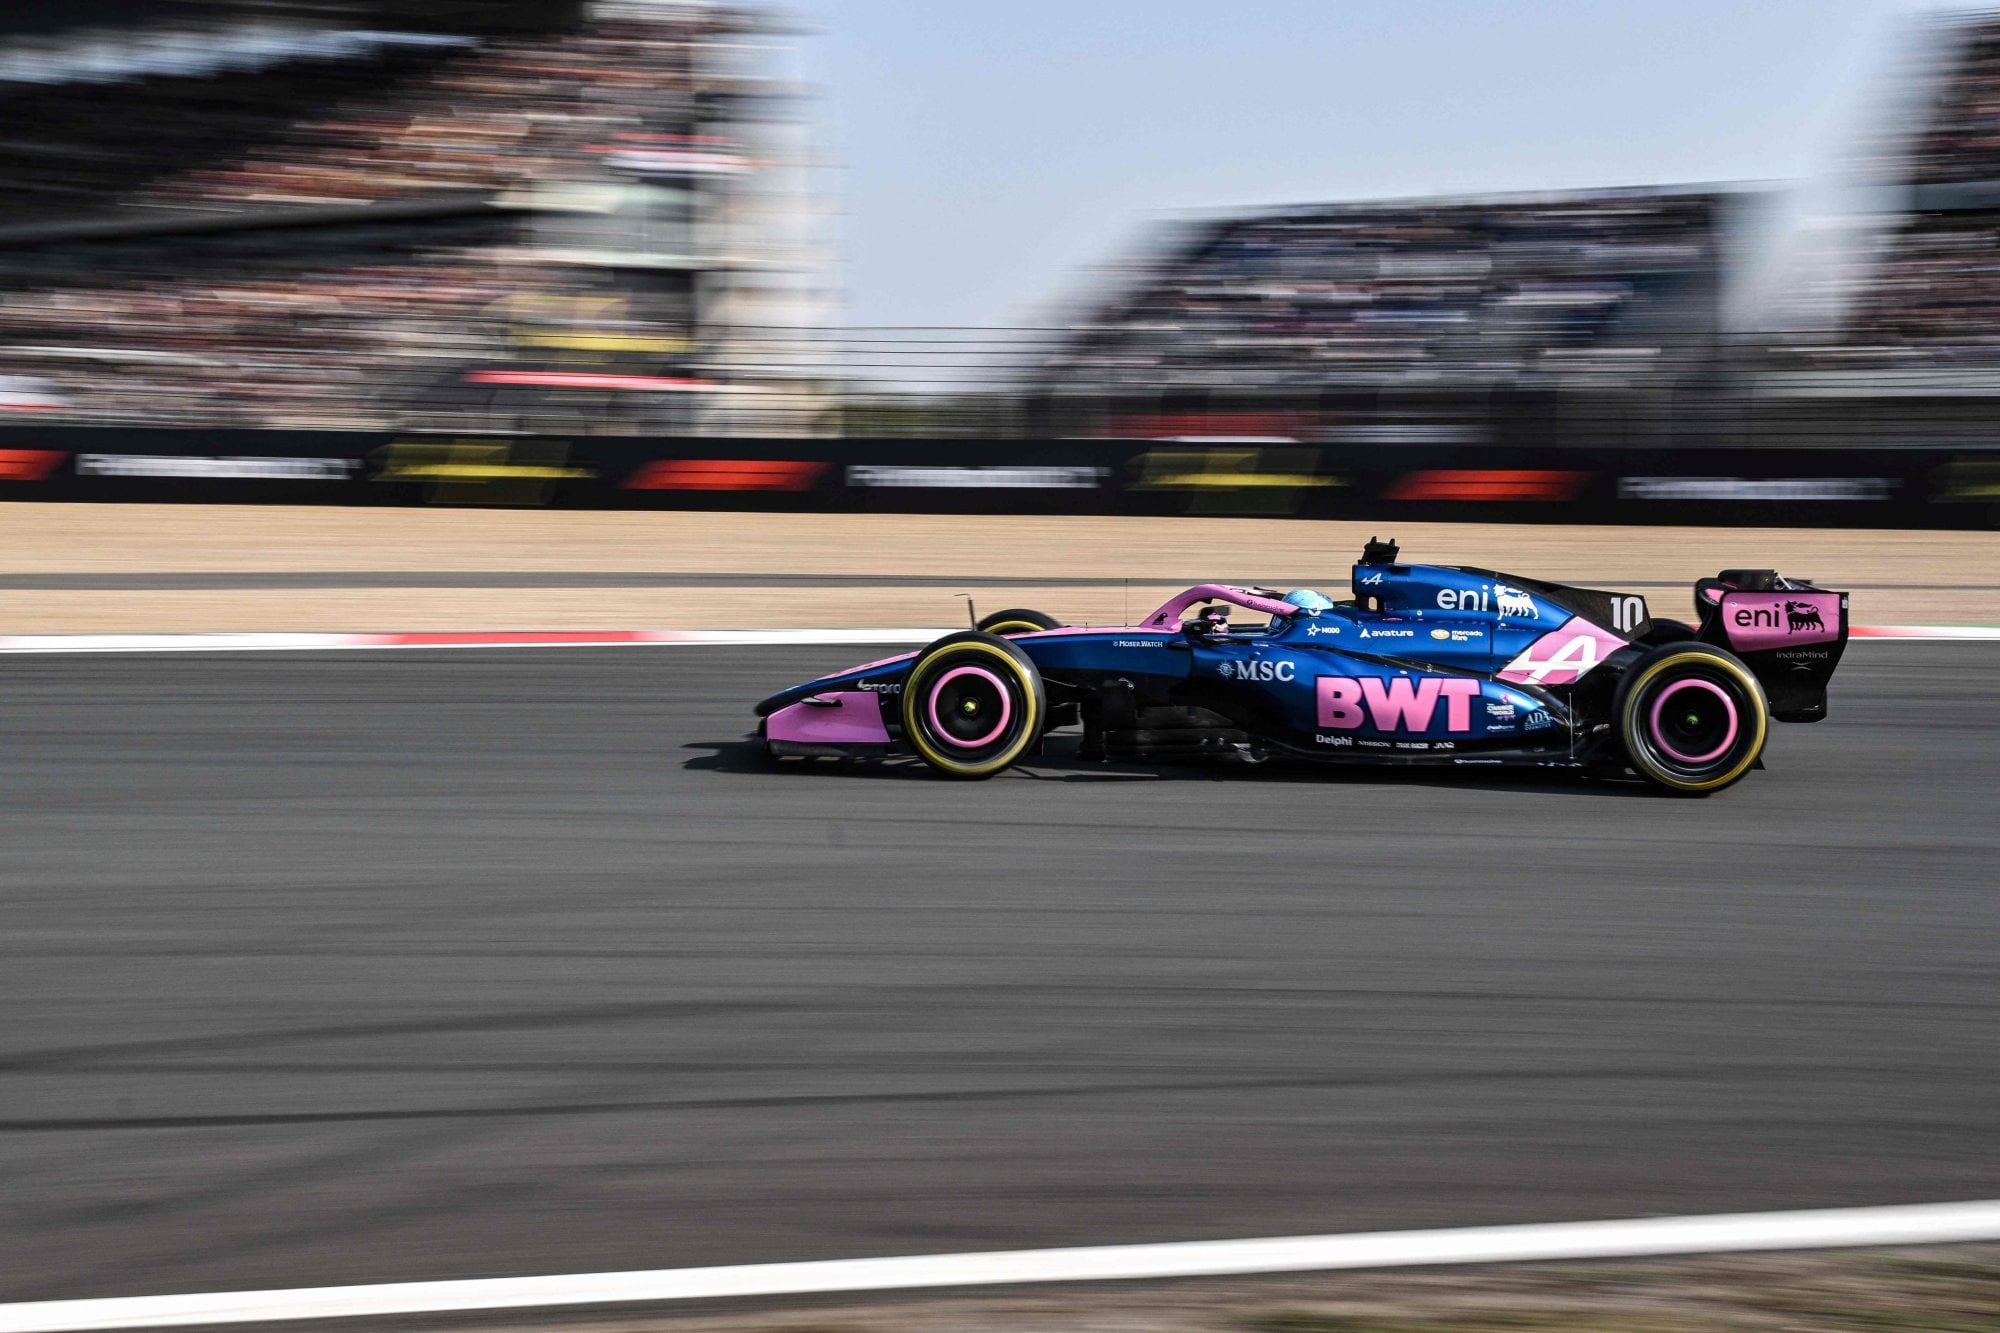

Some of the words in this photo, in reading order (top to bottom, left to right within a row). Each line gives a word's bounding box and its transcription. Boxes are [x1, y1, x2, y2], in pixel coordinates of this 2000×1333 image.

[1437, 584, 1488, 612] eni
[1611, 596, 1644, 633] 10
[1734, 603, 1780, 628] eni
[1371, 628, 1414, 637] avature
[1236, 660, 1295, 682] MSC
[1316, 676, 1481, 732] BWT
[1316, 734, 1353, 747] Delphi
